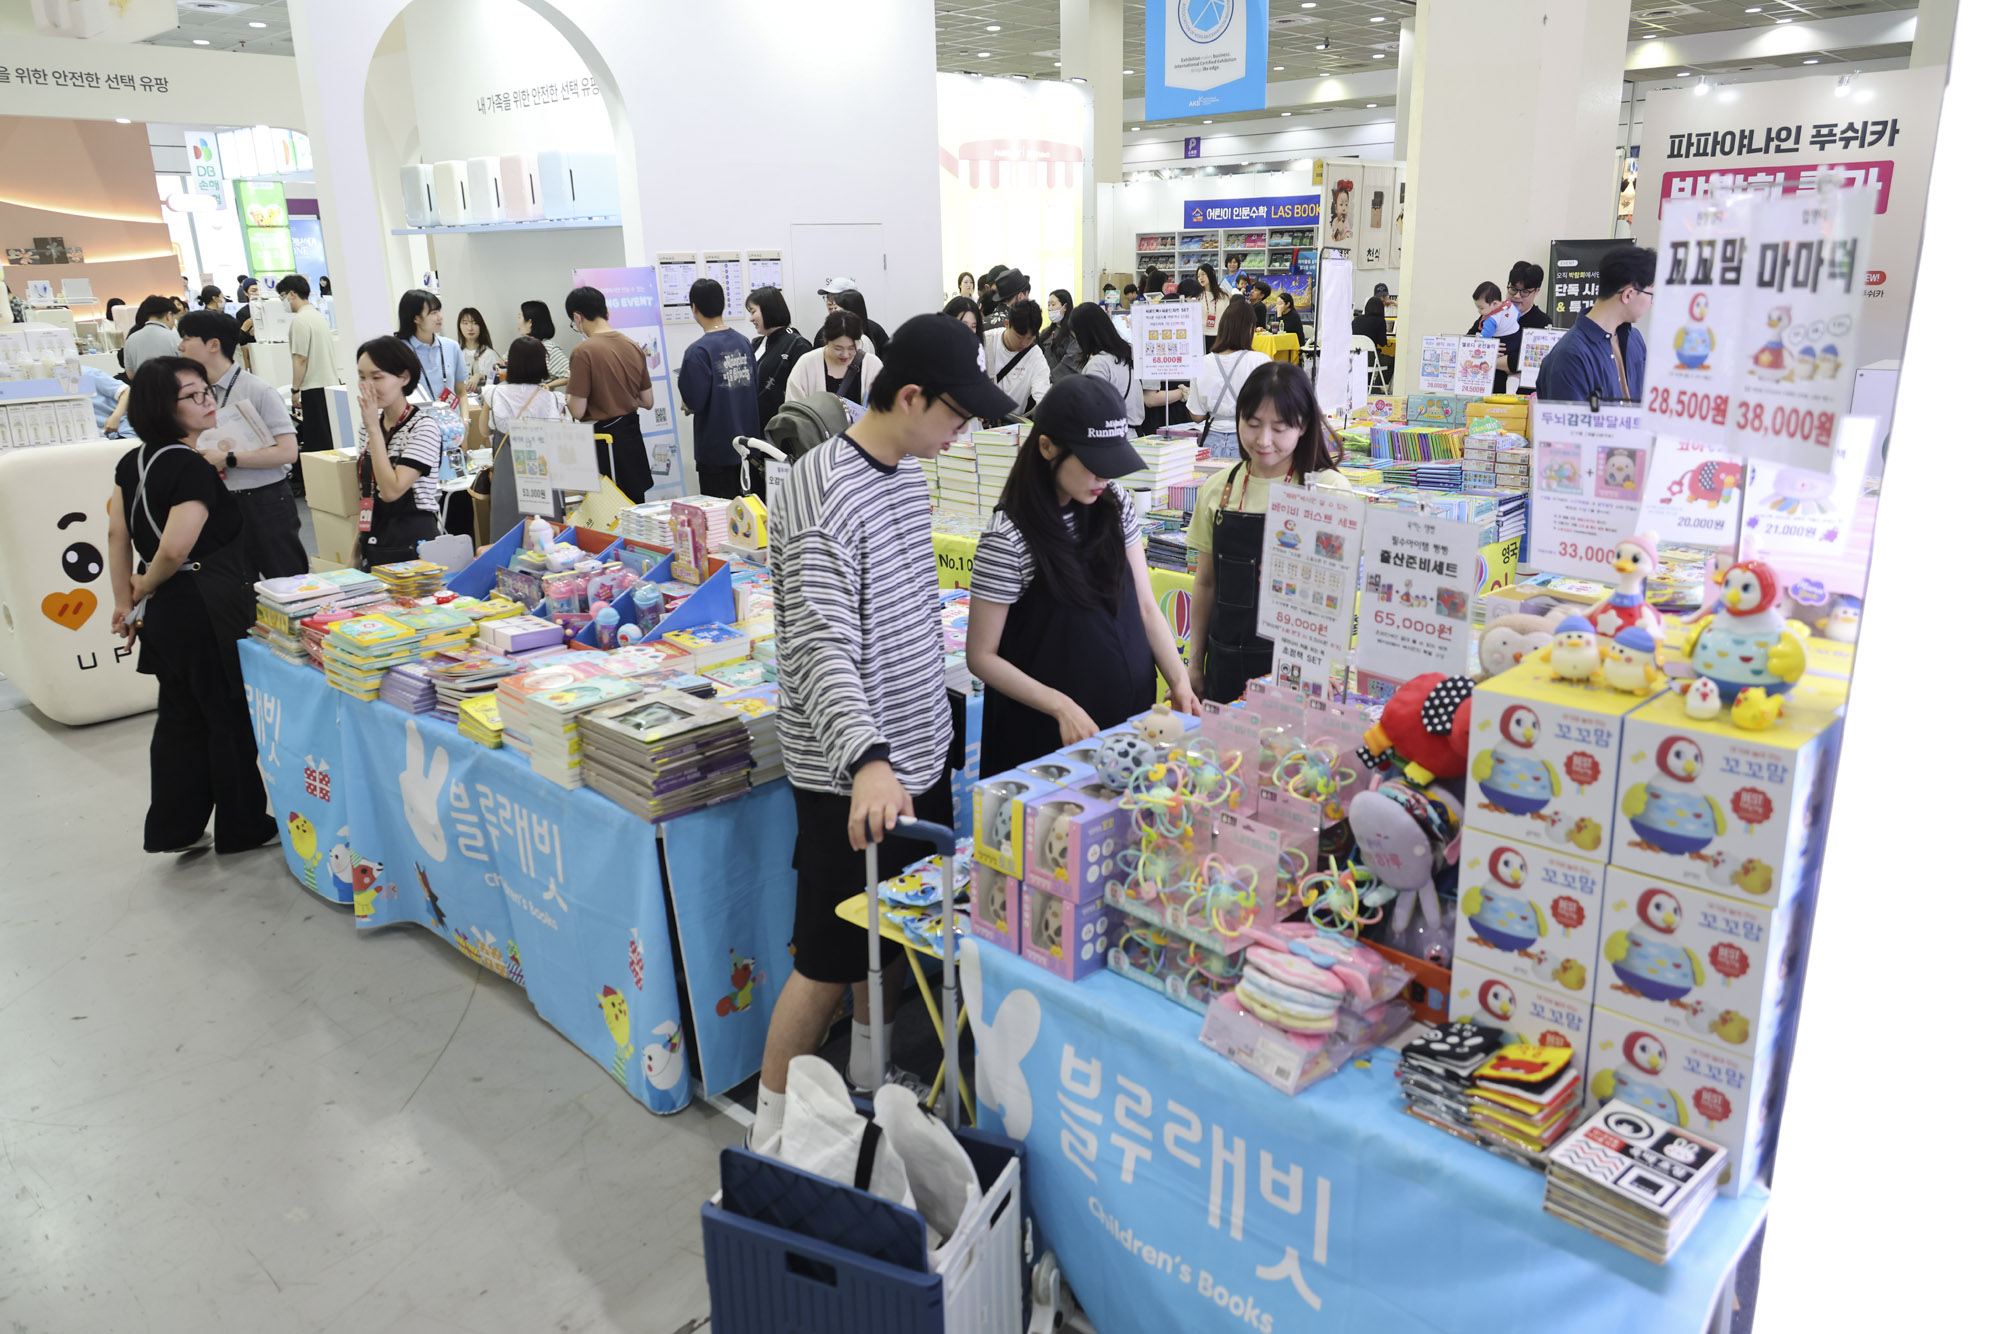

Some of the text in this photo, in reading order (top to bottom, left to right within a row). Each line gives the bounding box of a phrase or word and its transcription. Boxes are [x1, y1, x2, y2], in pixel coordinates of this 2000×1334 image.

[16, 68, 48, 86] 위한
[52, 70, 100, 88] 안전한
[105, 74, 136, 91] 선택
[140, 76, 168, 93] 유팡
[477, 96, 486, 115] 내
[487, 92, 511, 113] 가족을
[512, 88, 530, 108] 위한
[532, 83, 558, 106] 안전한
[561, 80, 579, 100] 선택
[1666, 118, 1900, 159] 파파야나인 푸쉬카
[196, 166, 216, 177] DB
[1206, 206, 1268, 220] 어린이 인문수학
[1271, 204, 1320, 218] LAS BOOK
[1665, 236, 1747, 286] 꼬꼬맘
[622, 295, 653, 308] EVENT
[1555, 283, 1580, 297] 단독
[1556, 302, 1566, 312] &
[1648, 386, 1731, 427] 28,500원
[1736, 400, 1835, 448] 38,000원
[1272, 502, 1358, 530] 베이비 퍼스트 세트
[1392, 535, 1430, 552] 필수아이템
[1501, 541, 1518, 565] 영국
[1380, 549, 1458, 578] 출산준비세트
[1374, 610, 1452, 642] 65,000원
[1306, 654, 1322, 666] SET
[1554, 723, 1612, 748] 꼬꼬맘
[1720, 756, 1788, 784] 꼬꼬맘
[1740, 792, 1764, 808] BEST
[1541, 866, 1596, 895] 꼬꼬맘
[1698, 911, 1764, 942] 꼬꼬맘
[1718, 946, 1740, 962] BEST
[1529, 1001, 1583, 1032] 꼬꼬맘
[1682, 1055, 1745, 1089] 꼬꼬맘
[1702, 1090, 1723, 1106] BEST
[1056, 1043, 1332, 1311] 블루래빗
[1088, 1196, 1274, 1334] Children's Books
